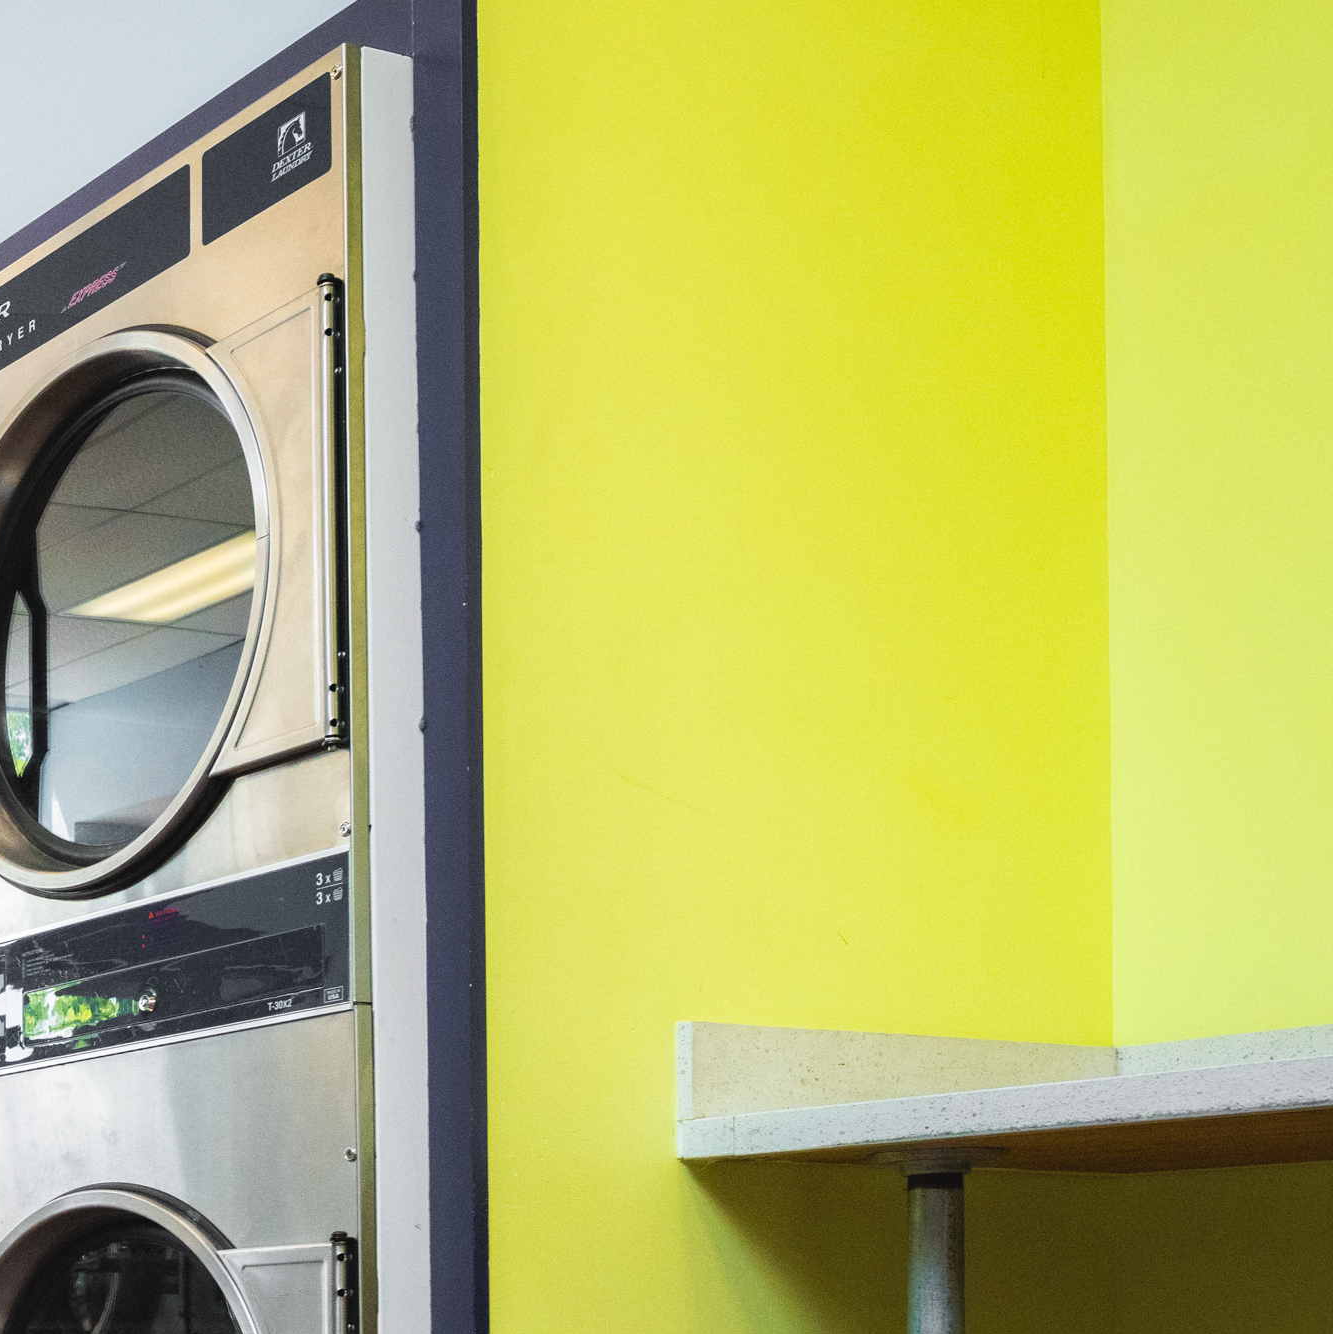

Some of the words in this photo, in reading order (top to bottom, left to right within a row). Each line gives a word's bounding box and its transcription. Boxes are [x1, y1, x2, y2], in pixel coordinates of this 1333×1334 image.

[271, 142, 312, 174] DEXTER
[271, 150, 313, 182] LAUNDRY
[67, 266, 120, 309] EXPRESS
[316, 872, 323, 886] 3
[325, 874, 331, 884] x
[316, 892, 323, 905] 3
[325, 894, 331, 903] x
[327, 992, 340, 1001] USA
[267, 999, 293, 1011] T-30X2
